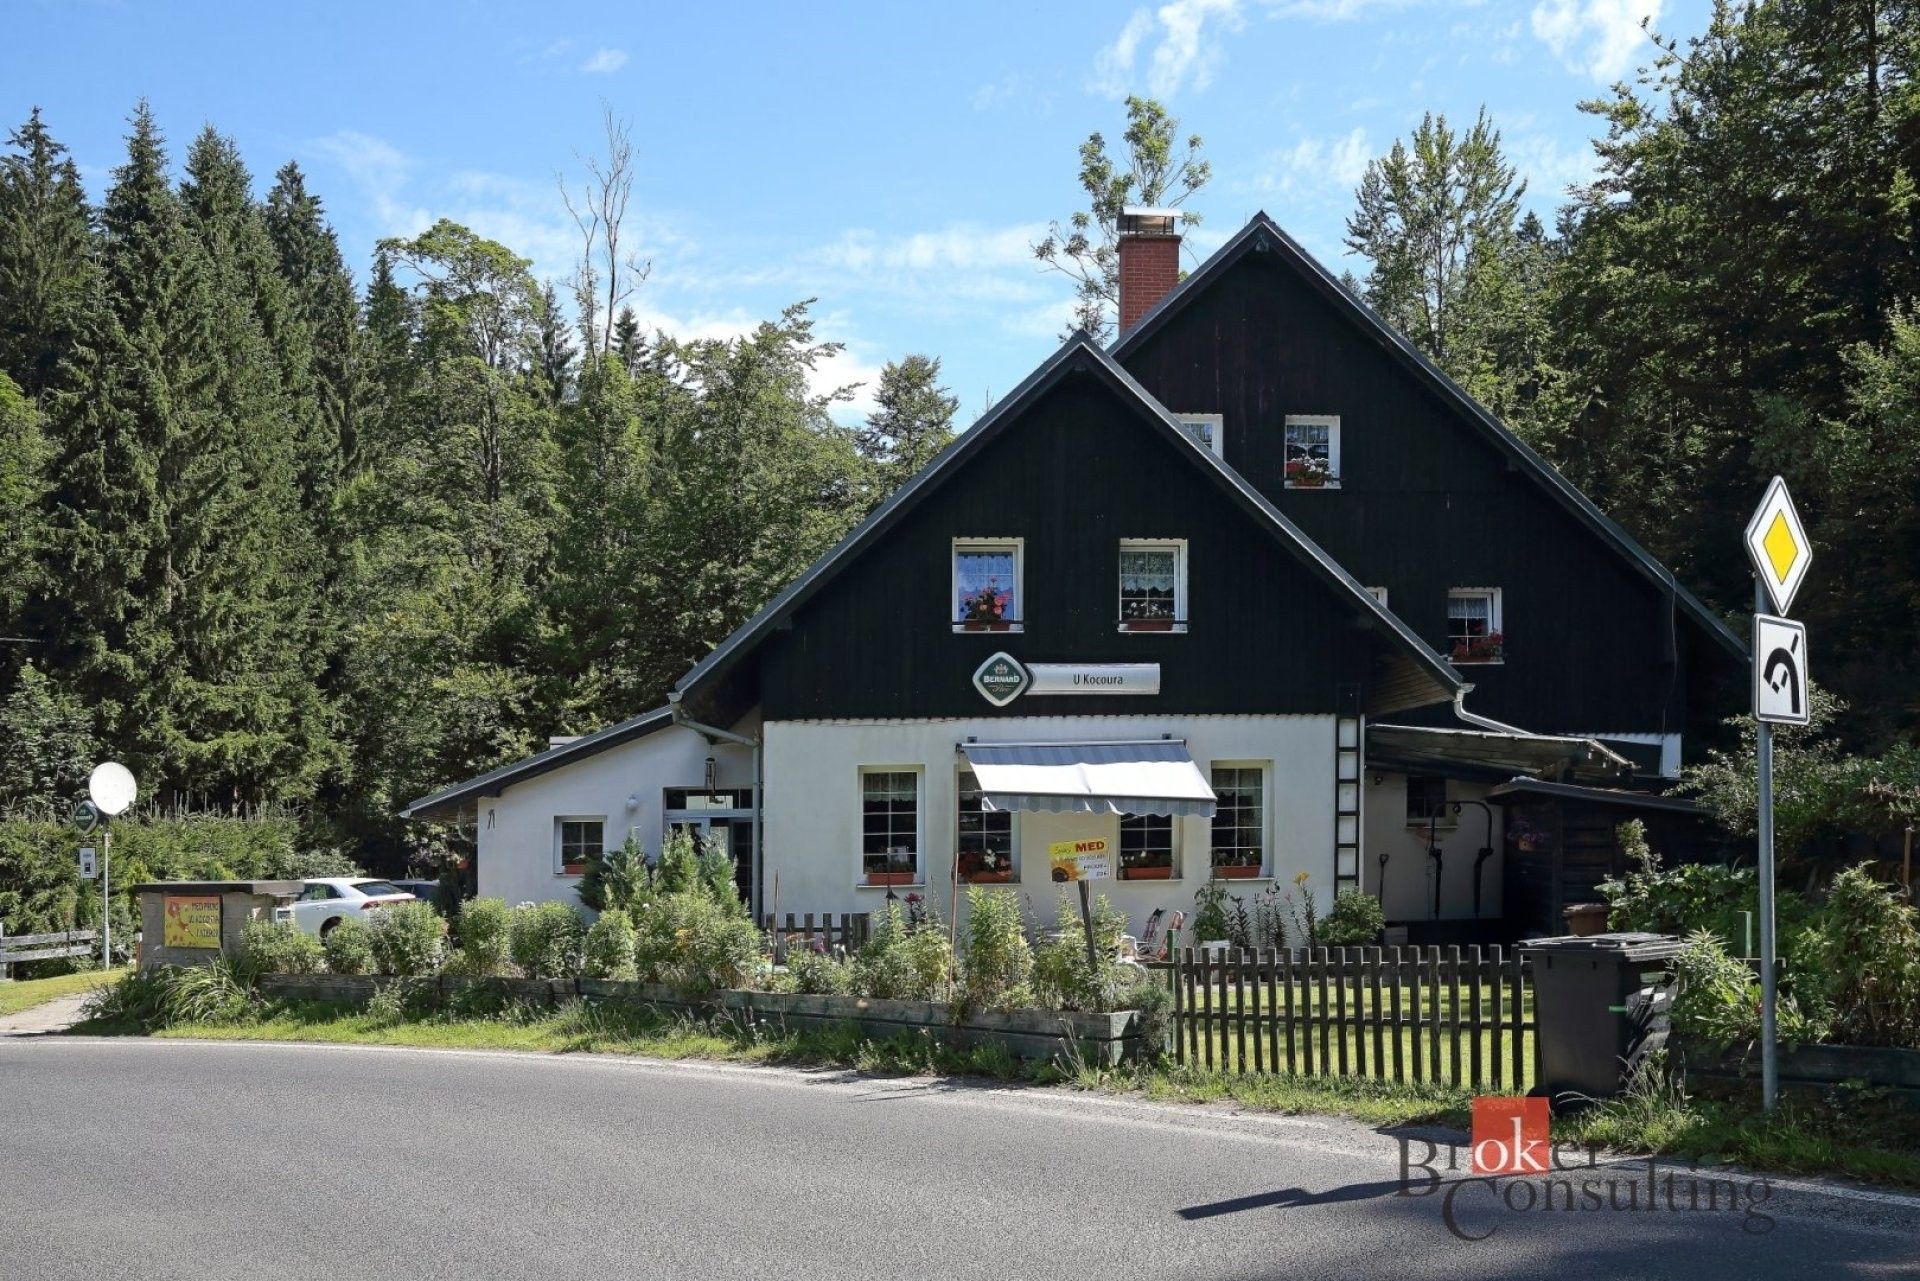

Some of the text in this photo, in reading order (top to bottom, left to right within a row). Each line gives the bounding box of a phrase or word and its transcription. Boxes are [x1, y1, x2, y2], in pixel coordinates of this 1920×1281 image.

[1073, 673, 1124, 685] U Kocoura
[1075, 841, 1105, 853] MED
